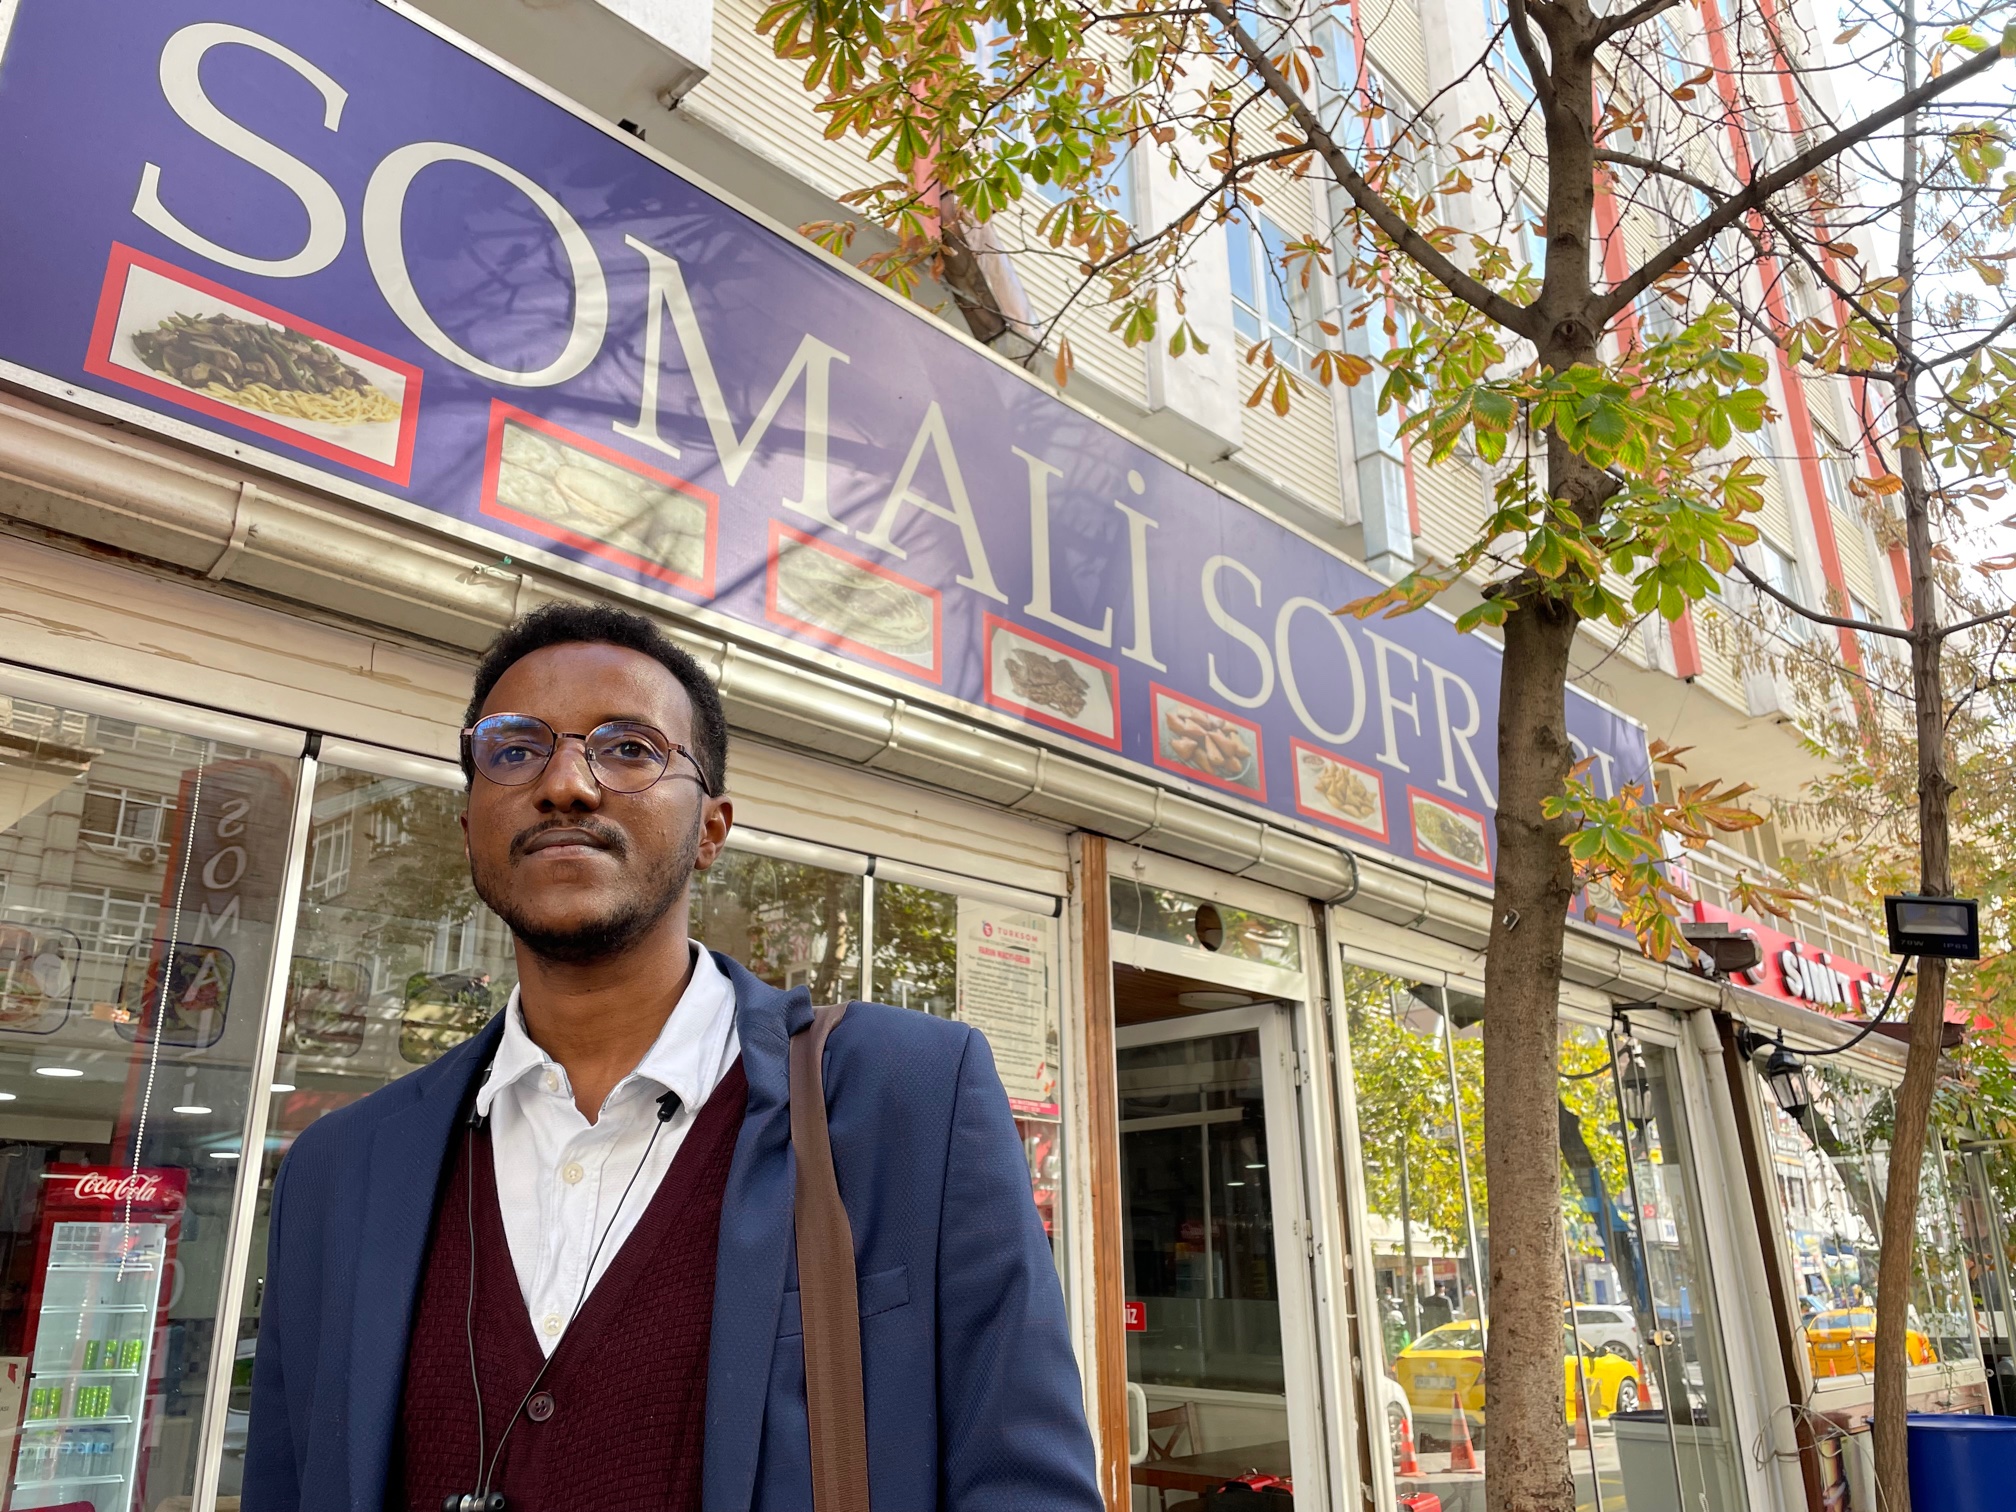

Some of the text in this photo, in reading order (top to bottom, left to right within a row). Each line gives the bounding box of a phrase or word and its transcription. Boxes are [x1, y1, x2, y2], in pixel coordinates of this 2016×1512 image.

[132, 23, 1616, 829] SOMALİ SOFRI
[74, 1171, 163, 1201] Coca-Cola
